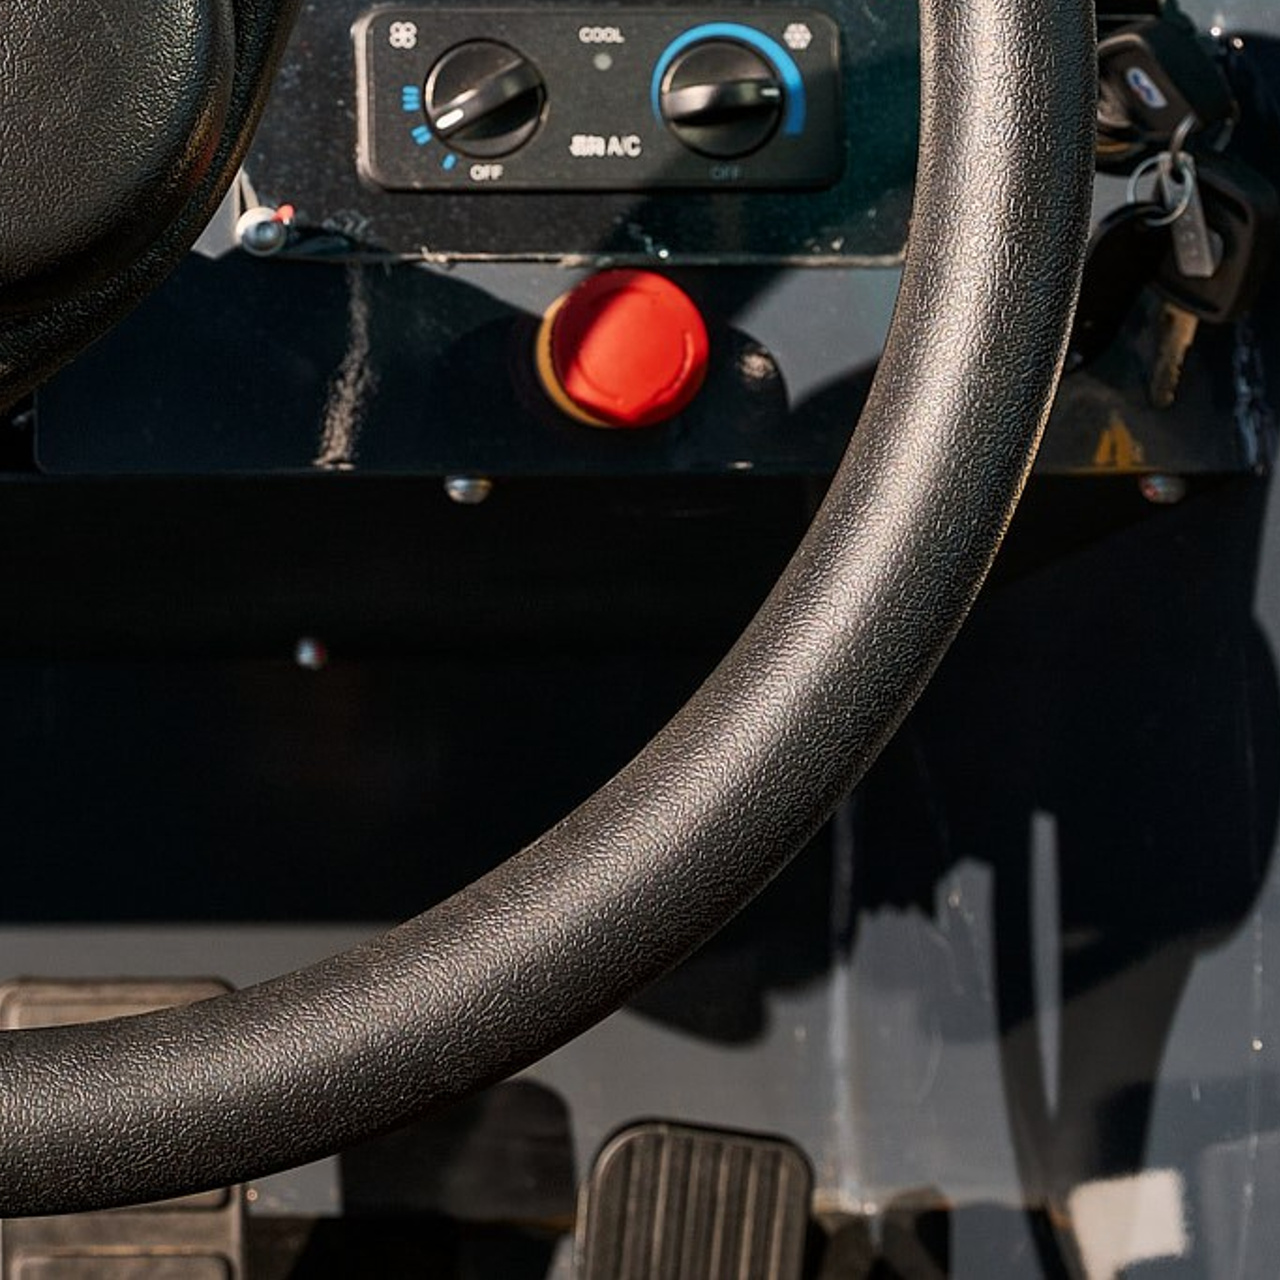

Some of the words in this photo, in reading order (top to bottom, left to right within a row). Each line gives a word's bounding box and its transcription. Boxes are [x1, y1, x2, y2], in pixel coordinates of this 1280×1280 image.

[578, 26, 626, 44] COOL
[606, 134, 643, 157] A/C
[469, 164, 505, 181] OFF
